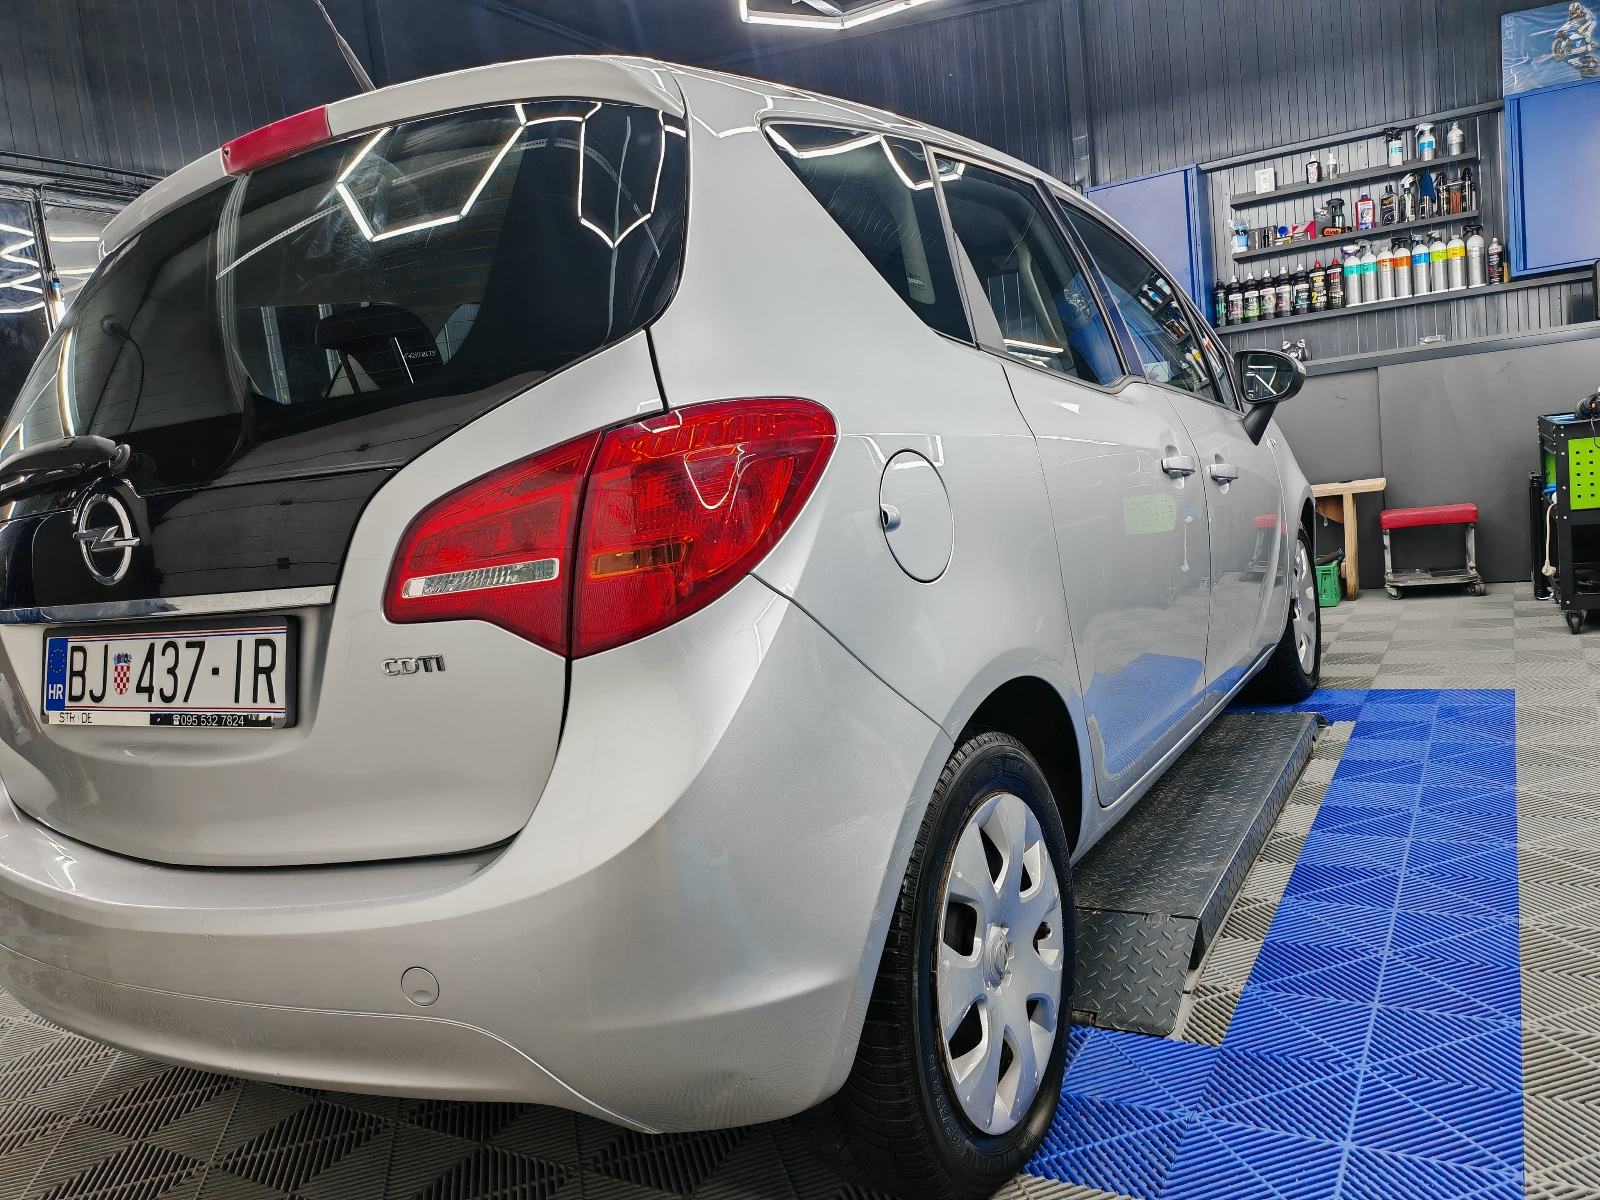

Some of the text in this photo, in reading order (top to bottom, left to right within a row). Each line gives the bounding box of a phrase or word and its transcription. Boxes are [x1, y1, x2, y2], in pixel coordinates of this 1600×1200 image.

[68, 644, 109, 703] BJ
[381, 654, 446, 676] CDTI
[48, 684, 64, 700] HR
[181, 715, 198, 726] 095
[200, 714, 219, 726] 532
[221, 714, 245, 727] 7824
